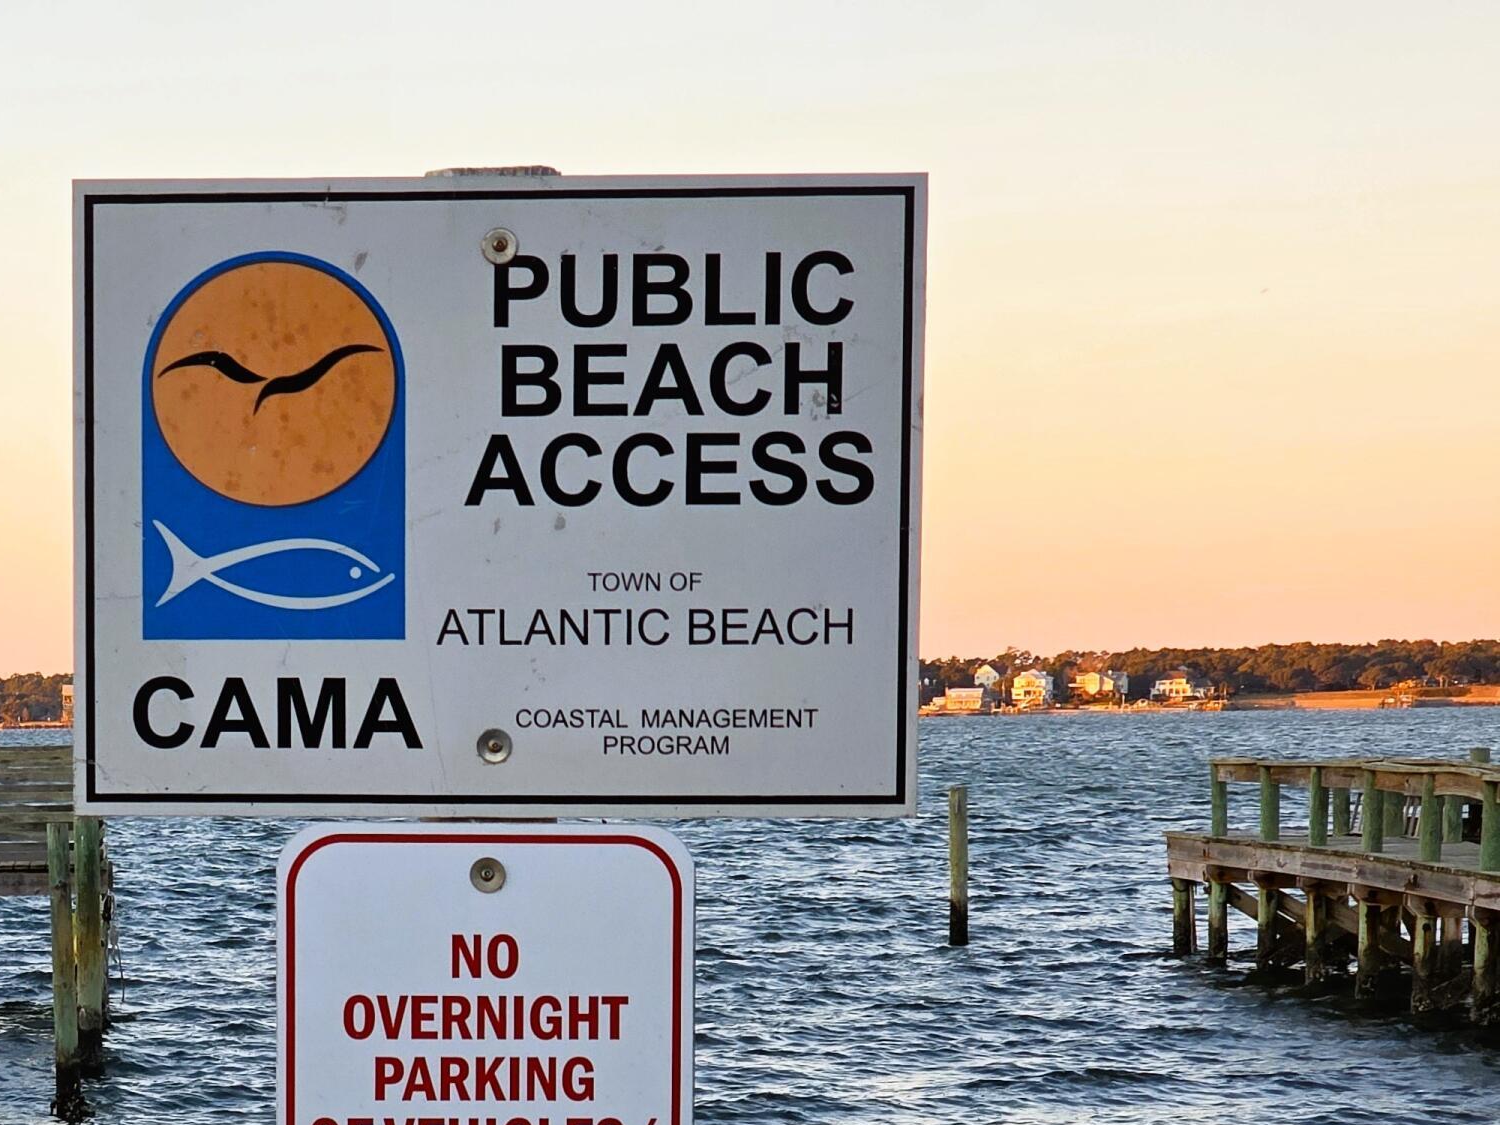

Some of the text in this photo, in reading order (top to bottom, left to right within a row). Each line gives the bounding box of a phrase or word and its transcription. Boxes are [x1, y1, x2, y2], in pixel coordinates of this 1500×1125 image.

[493, 250, 855, 327] PUBLIC
[502, 342, 842, 416] BEACH
[465, 431, 874, 506] ACCESS
[587, 572, 702, 592] TOWN OF
[437, 608, 853, 645] ATLANTIC BEACH
[133, 677, 423, 748] CAMA
[516, 709, 818, 728] COASTAL MANAGEMENT
[604, 736, 729, 755] PROGRAM
[452, 934, 518, 978] NO
[344, 995, 627, 1039] OVERNIGHT
[375, 1057, 593, 1100] PARKING
